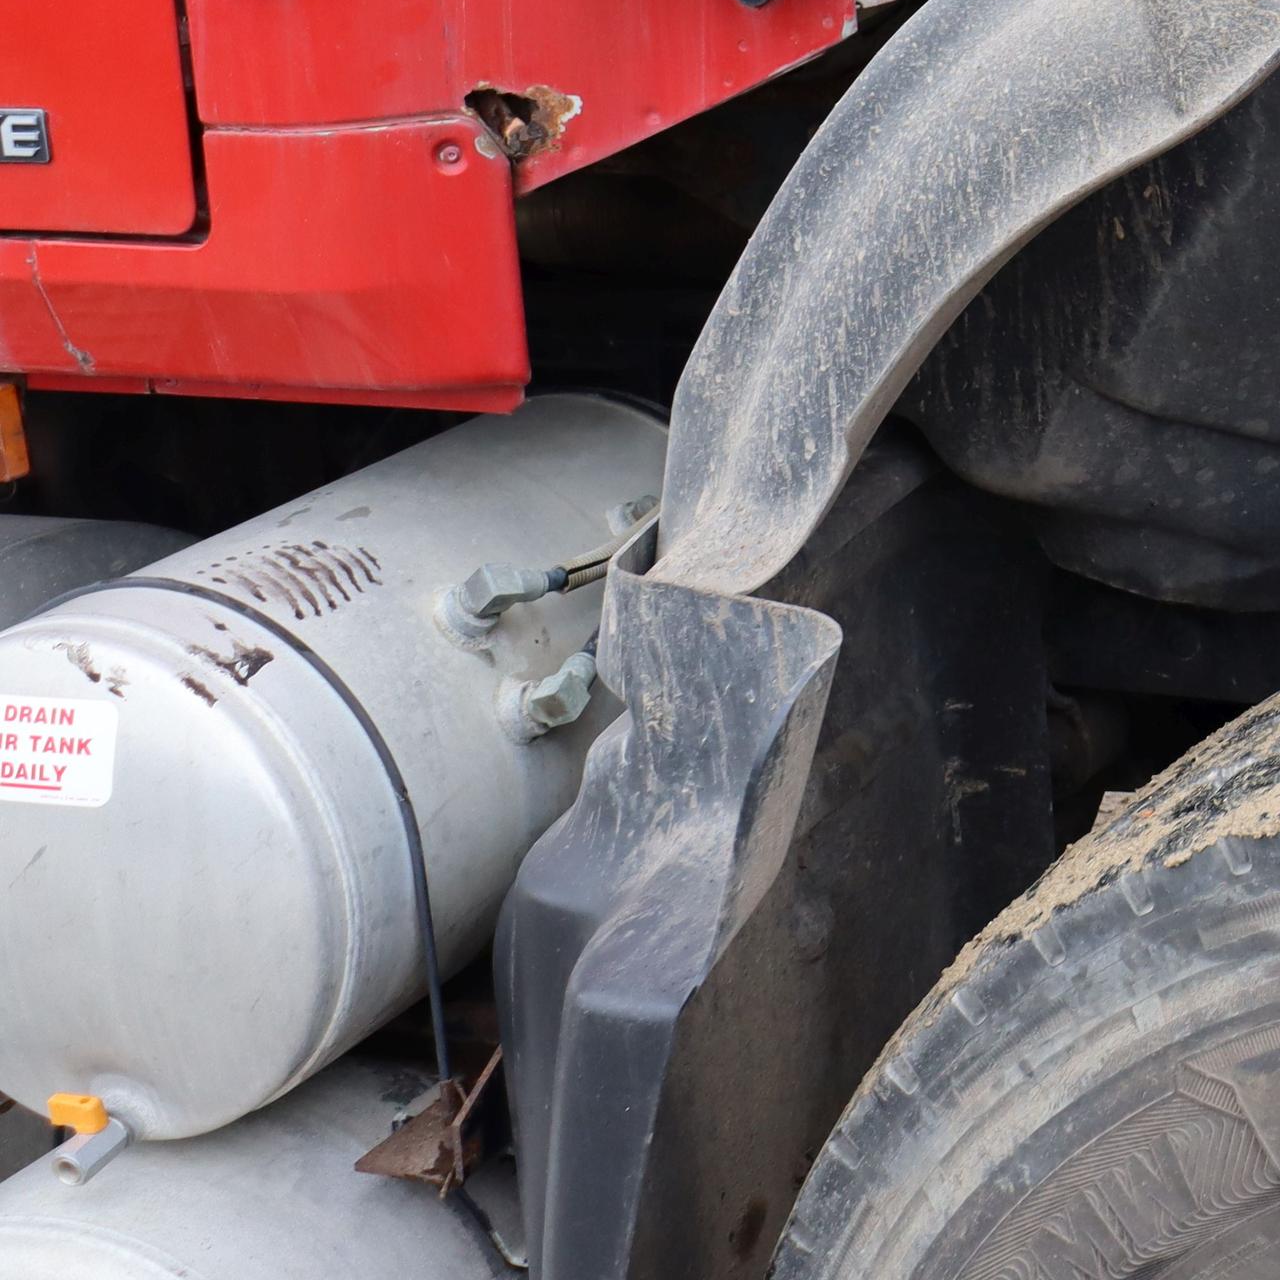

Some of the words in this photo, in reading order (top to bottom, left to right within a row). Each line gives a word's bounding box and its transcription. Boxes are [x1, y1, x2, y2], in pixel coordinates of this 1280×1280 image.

[4, 704, 75, 725] DRAIN
[0, 732, 18, 751] IR
[30, 735, 93, 756] TANK
[1, 761, 67, 782] DAILY
